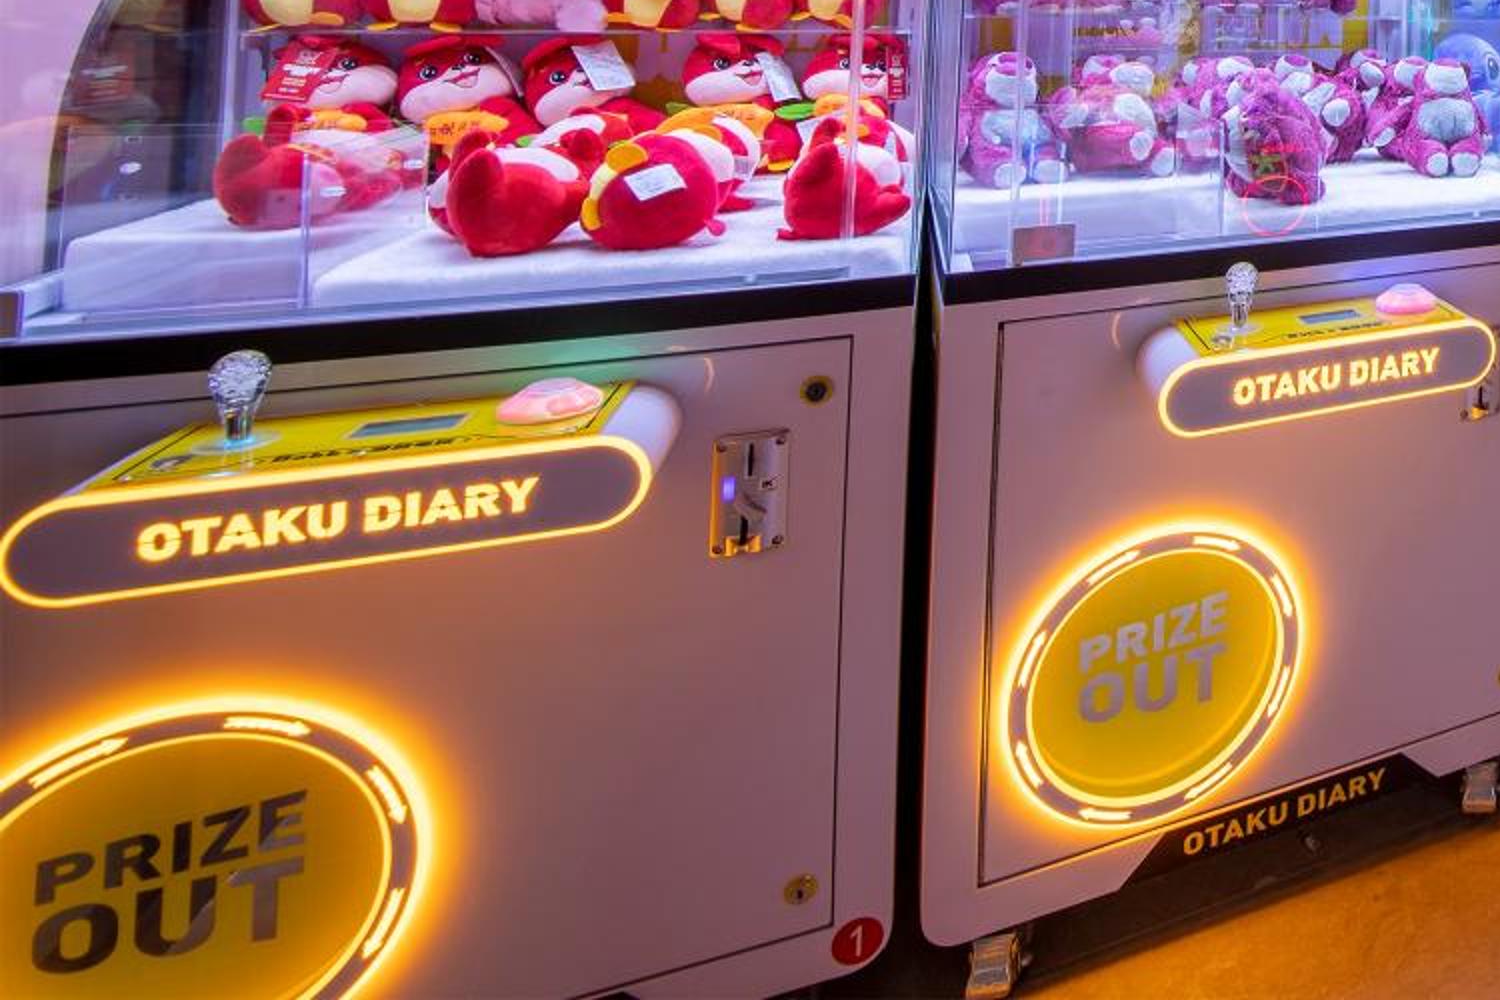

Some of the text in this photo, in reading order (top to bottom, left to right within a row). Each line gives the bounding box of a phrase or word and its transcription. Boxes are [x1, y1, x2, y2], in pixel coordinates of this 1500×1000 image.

[1232, 347, 1440, 407] OTAKU DIARY
[136, 477, 541, 563] OTAKU DIARY
[1077, 592, 1231, 674] PRIZE
[1077, 643, 1229, 724] OUT
[34, 789, 310, 906] PRIZE
[1182, 768, 1388, 857] OTAKU DIARY
[31, 855, 305, 975] OUT
[849, 925, 868, 959] 1
